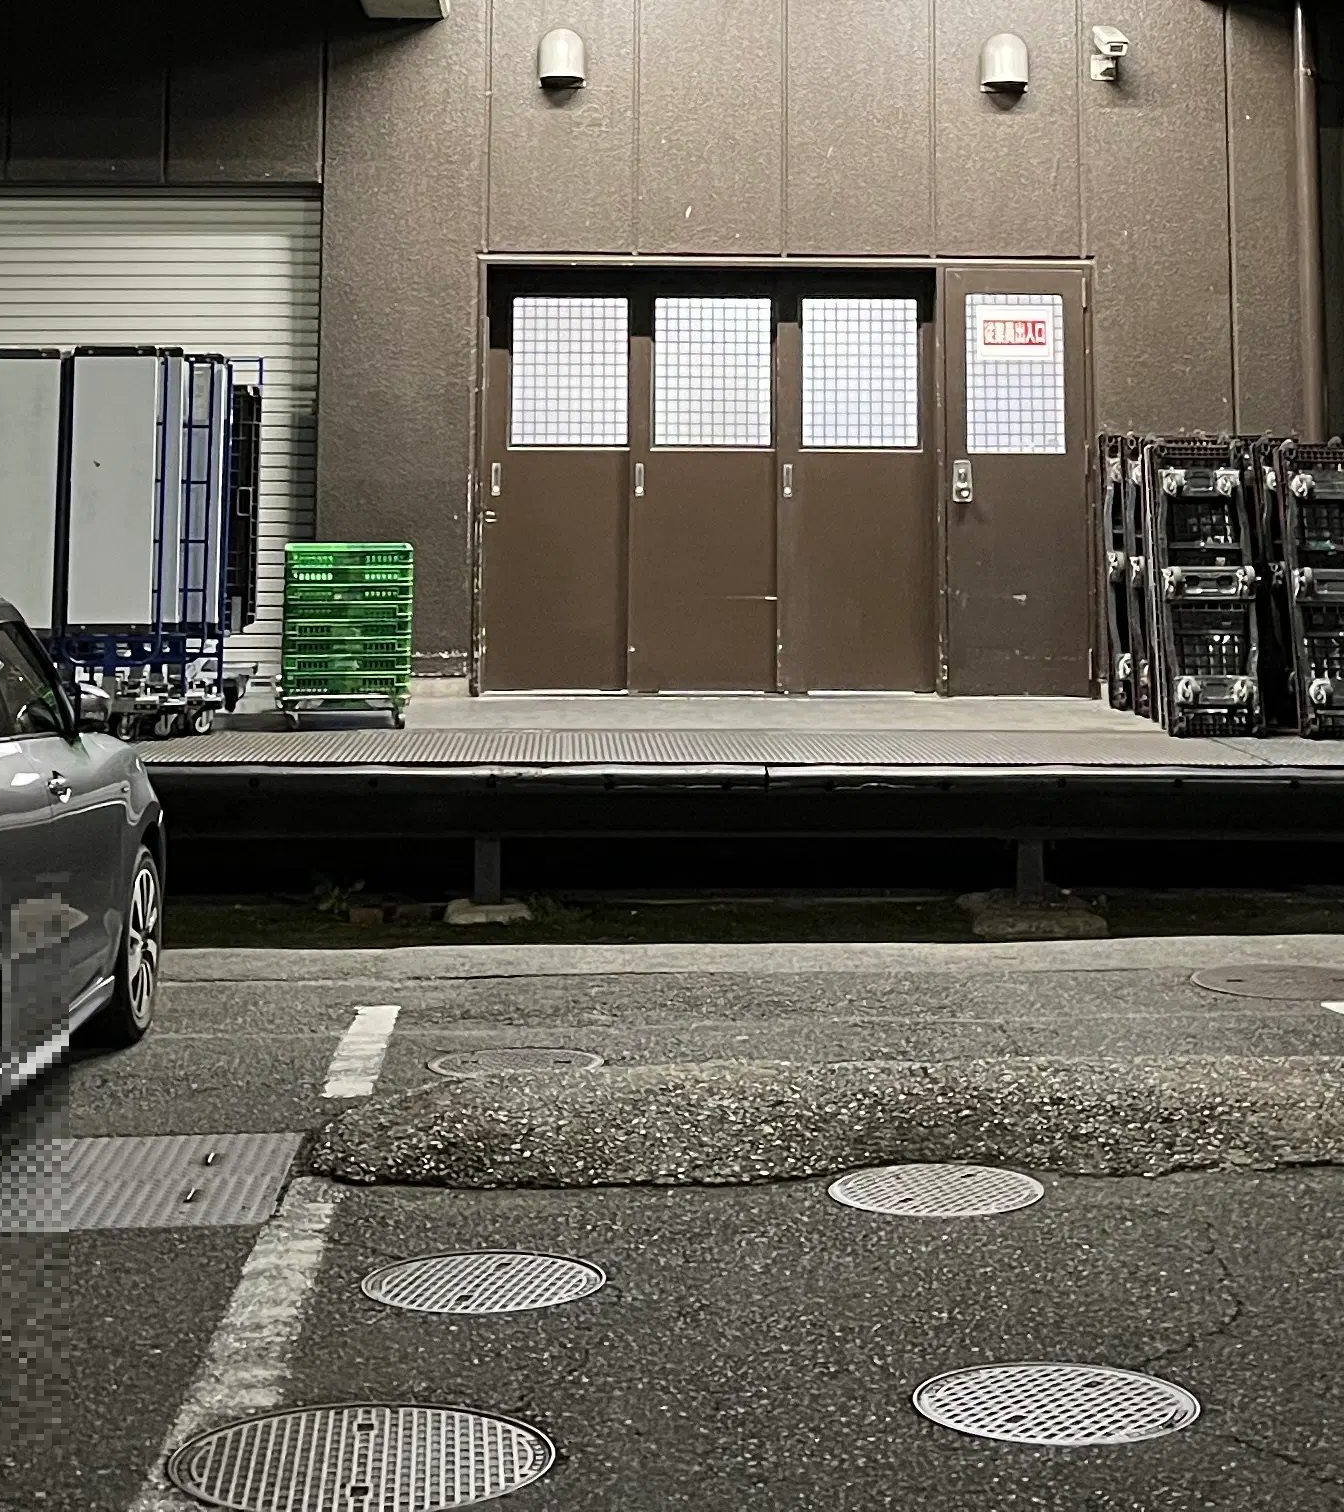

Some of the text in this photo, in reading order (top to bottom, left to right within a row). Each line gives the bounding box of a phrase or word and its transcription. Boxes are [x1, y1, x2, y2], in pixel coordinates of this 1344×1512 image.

[984, 321, 1046, 345] 従業員出入口
